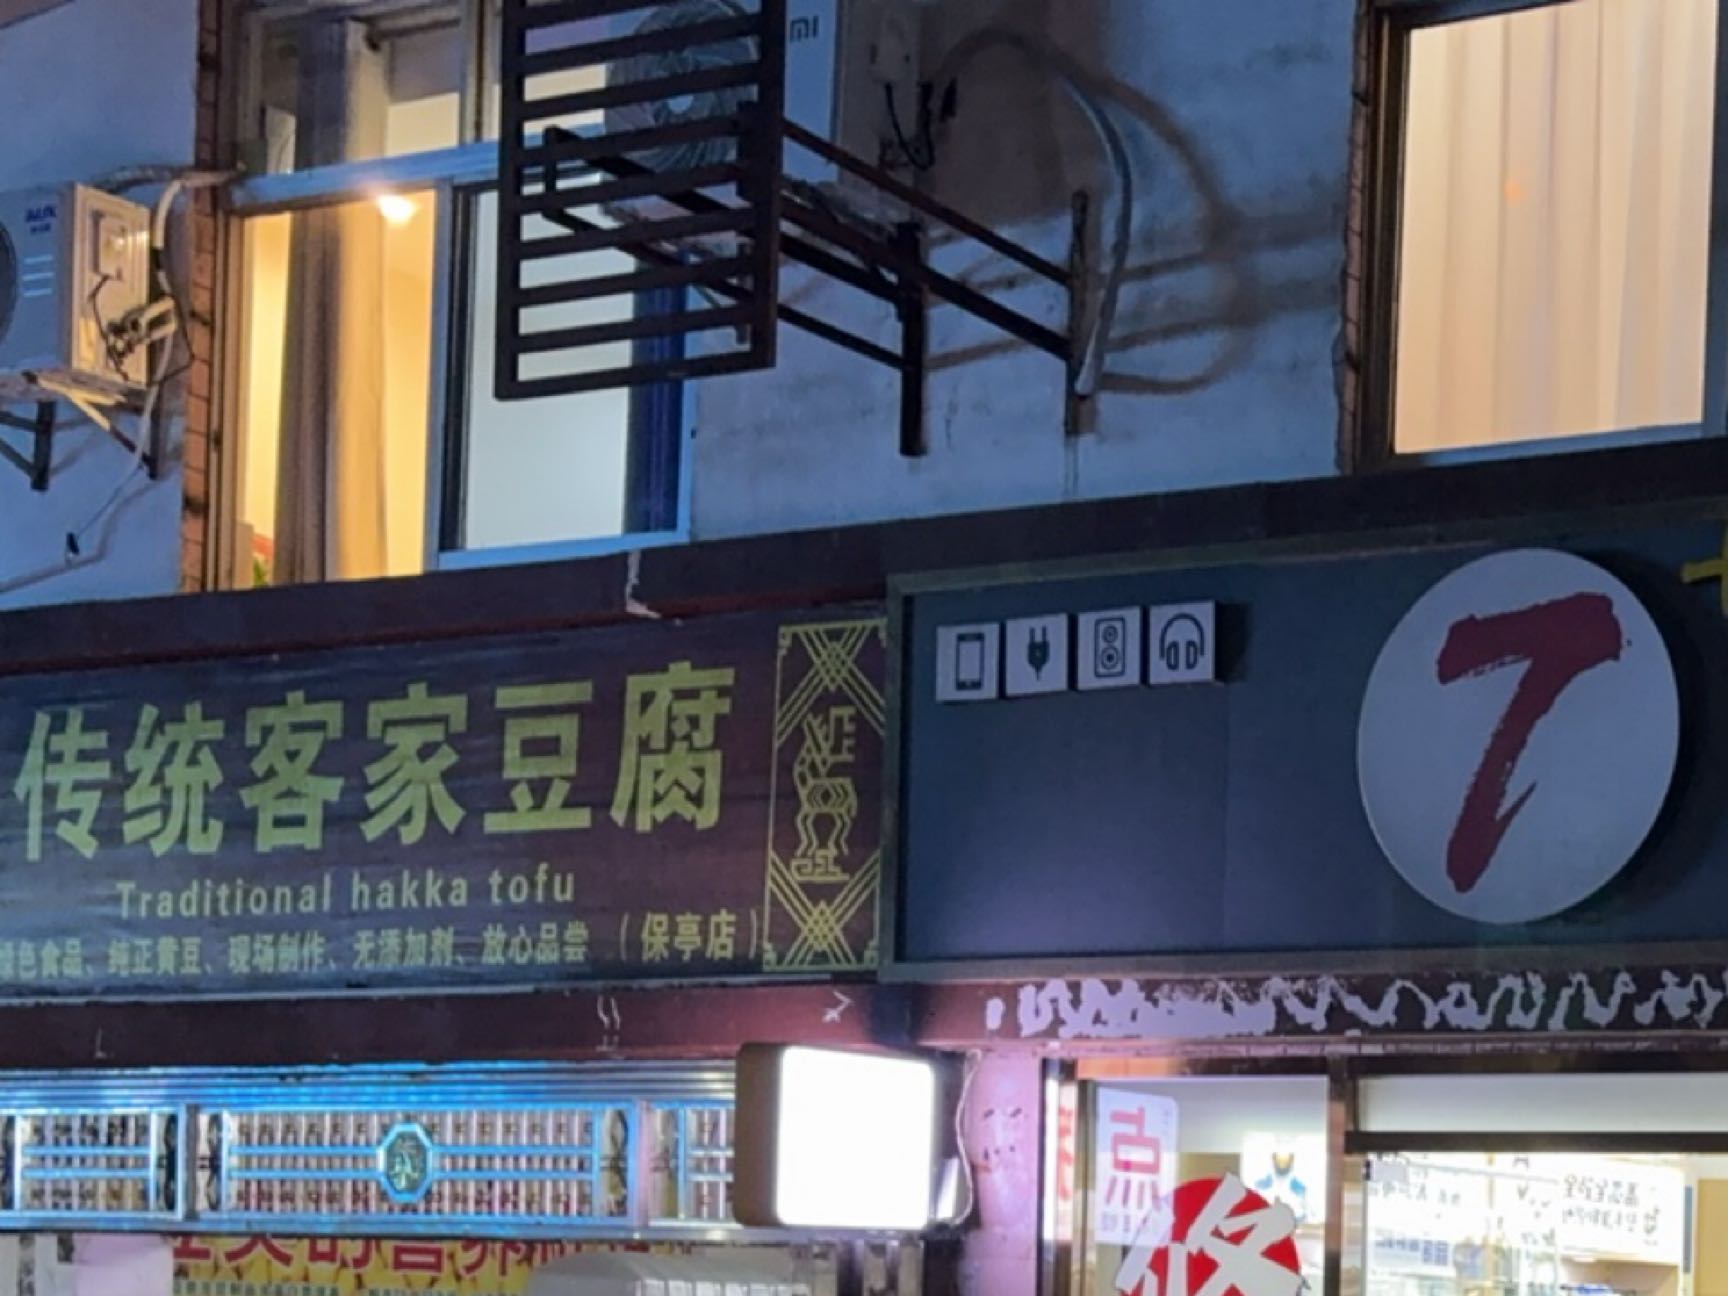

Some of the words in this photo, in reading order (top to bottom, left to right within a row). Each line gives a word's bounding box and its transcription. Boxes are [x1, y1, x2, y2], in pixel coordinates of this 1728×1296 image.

[14, 661, 735, 863] 传统客家豆腐
[116, 871, 331, 920] Traditional
[350, 866, 469, 910] hakka
[488, 862, 576, 904] tofu
